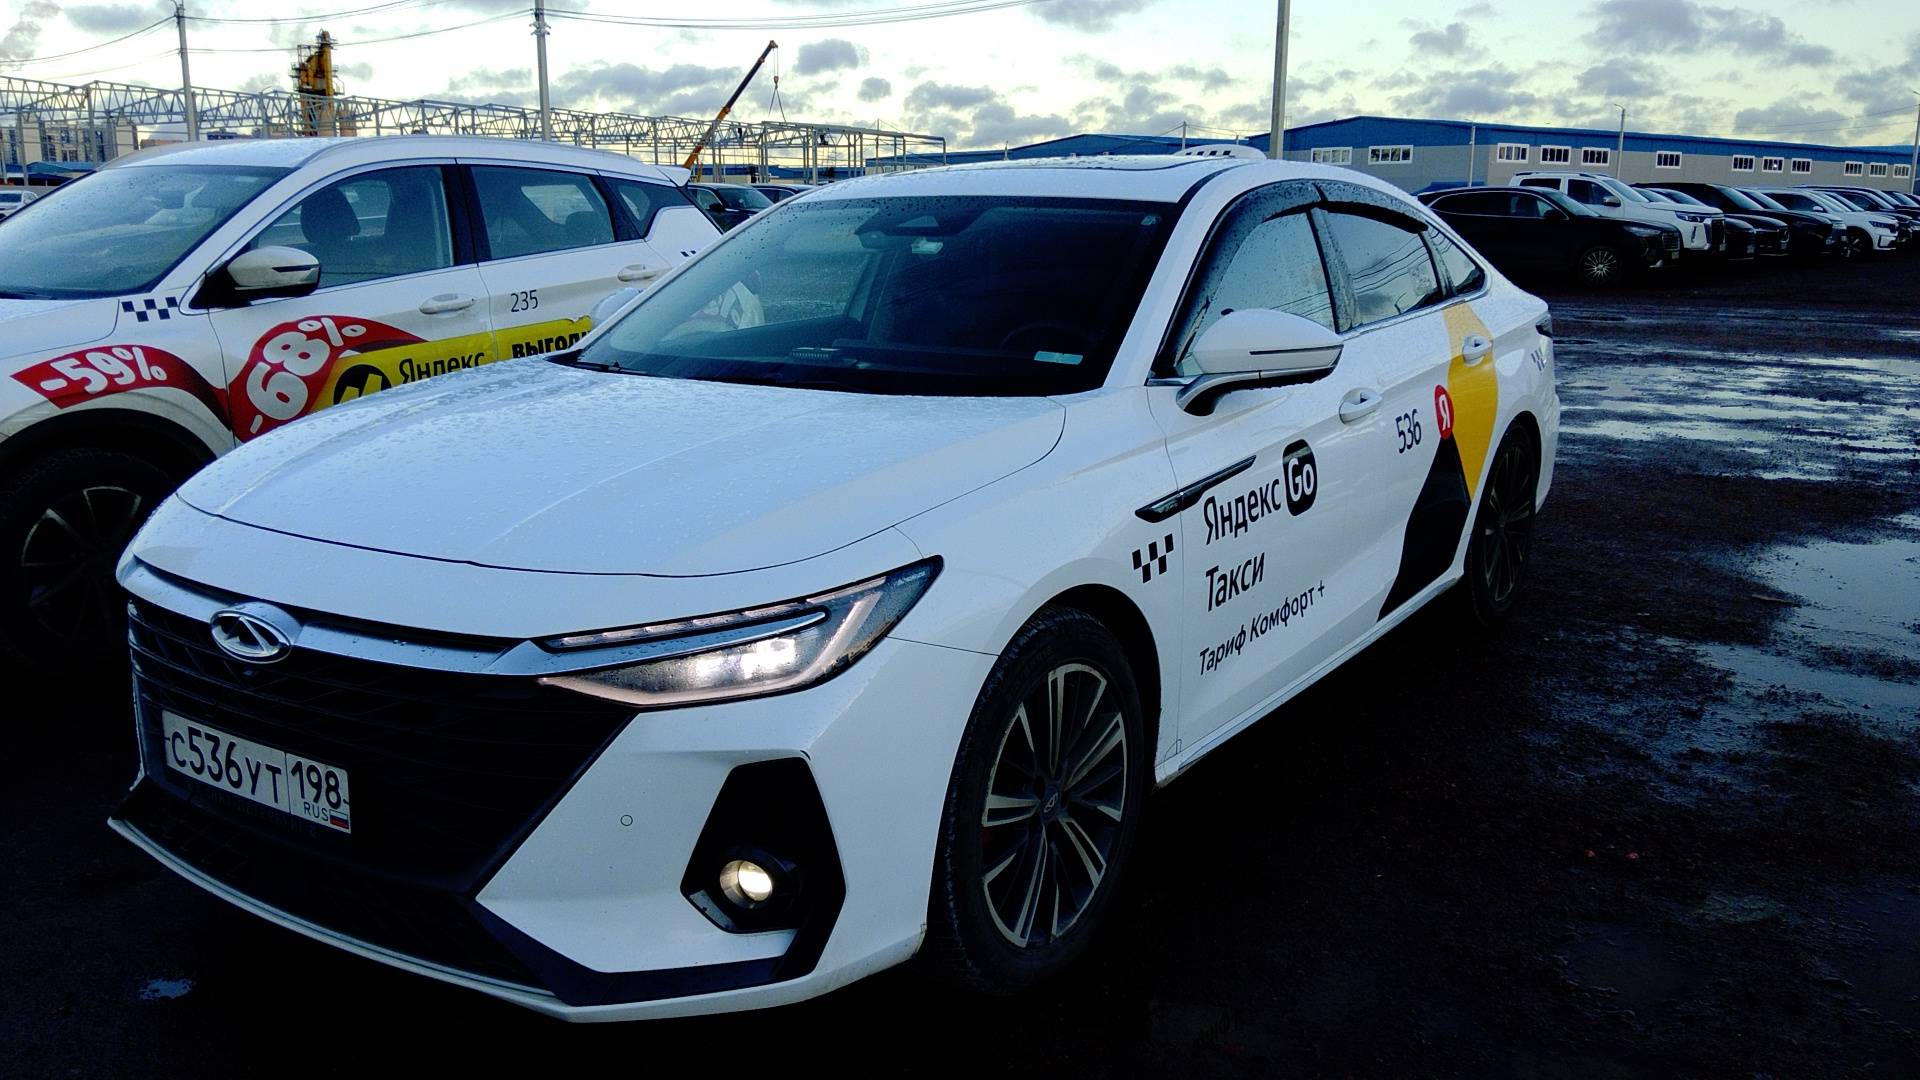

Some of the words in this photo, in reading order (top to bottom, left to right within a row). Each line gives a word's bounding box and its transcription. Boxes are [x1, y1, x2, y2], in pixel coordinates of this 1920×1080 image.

[510, 289, 539, 313] 235
[40, 347, 168, 394] -59%
[250, 317, 367, 434] -68%
[1395, 408, 1422, 454] 536
[1438, 393, 1451, 431] Я
[1203, 478, 1281, 545] Яндекс
[1287, 457, 1315, 502] Go
[1205, 552, 1266, 612] Такси
[1200, 624, 1246, 676] Тариф
[1250, 586, 1315, 642] Комфорт
[290, 759, 342, 810] 198
[303, 801, 329, 822] RUS
